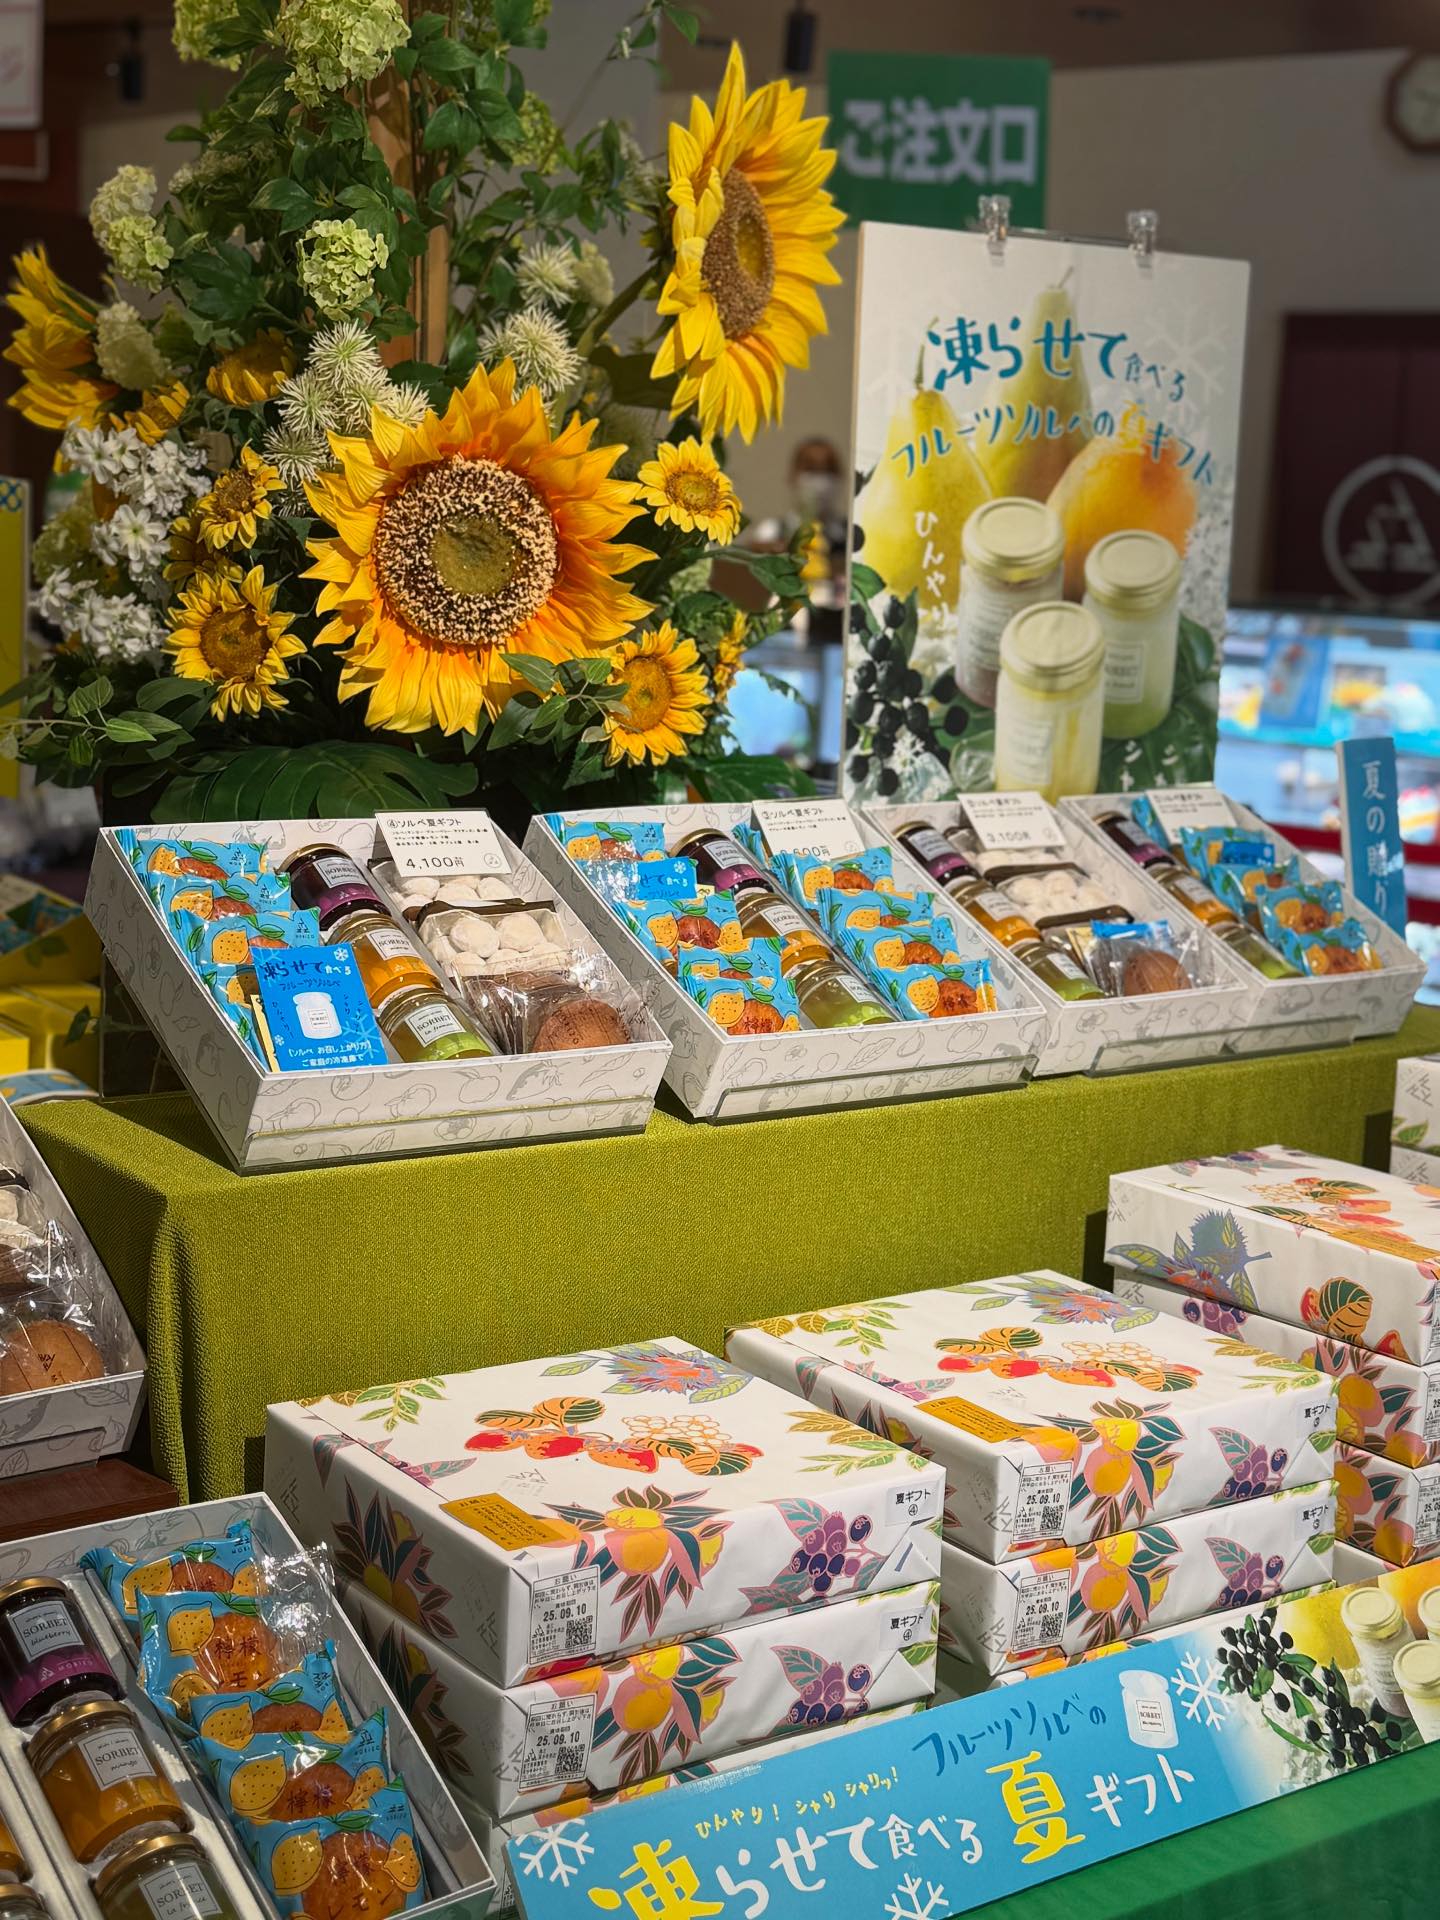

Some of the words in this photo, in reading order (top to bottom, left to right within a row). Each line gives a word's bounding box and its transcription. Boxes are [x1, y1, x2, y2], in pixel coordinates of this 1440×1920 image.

[843, 97, 1037, 185] ご注文口
[895, 1489, 931, 1504] 夏ギフト
[1026, 1493, 1060, 1505] 25.09.10
[543, 1603, 587, 1622] 25.09.10
[1026, 1601, 1060, 1616] 25.09.10
[23, 1618, 68, 1639] SORBET
[890, 1613, 924, 1629] 夏ギフト
[536, 1730, 580, 1747] 25.09.10
[912, 1693, 1107, 1777] フルーツソルベの
[95, 1747, 139, 1766] SORBET
